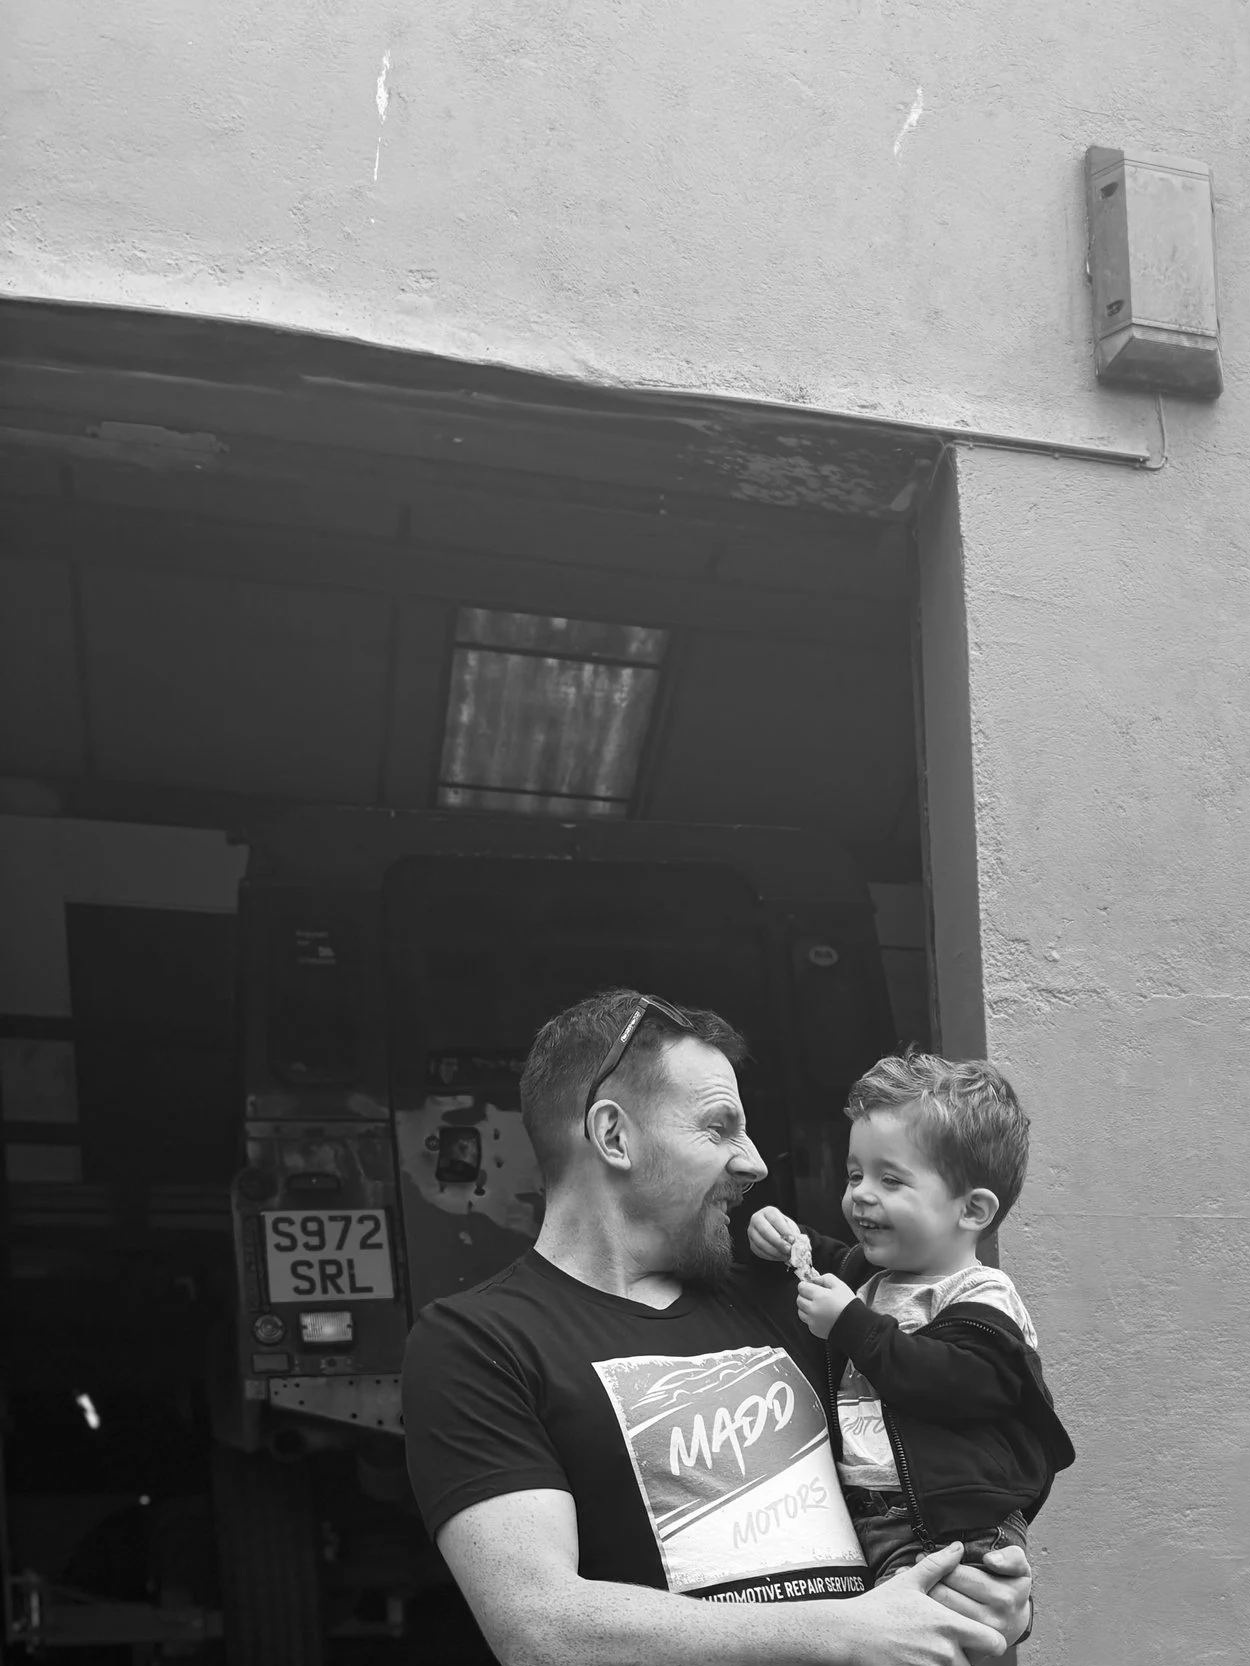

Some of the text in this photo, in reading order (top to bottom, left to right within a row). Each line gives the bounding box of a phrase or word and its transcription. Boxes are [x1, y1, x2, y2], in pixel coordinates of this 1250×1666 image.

[271, 1214, 384, 1253] S972
[289, 1258, 374, 1296] SRL
[669, 1380, 795, 1477] MADD
[732, 1476, 830, 1549] MOTORS
[783, 1577, 826, 1598] REPAIR
[824, 1576, 865, 1592] SERVICES
